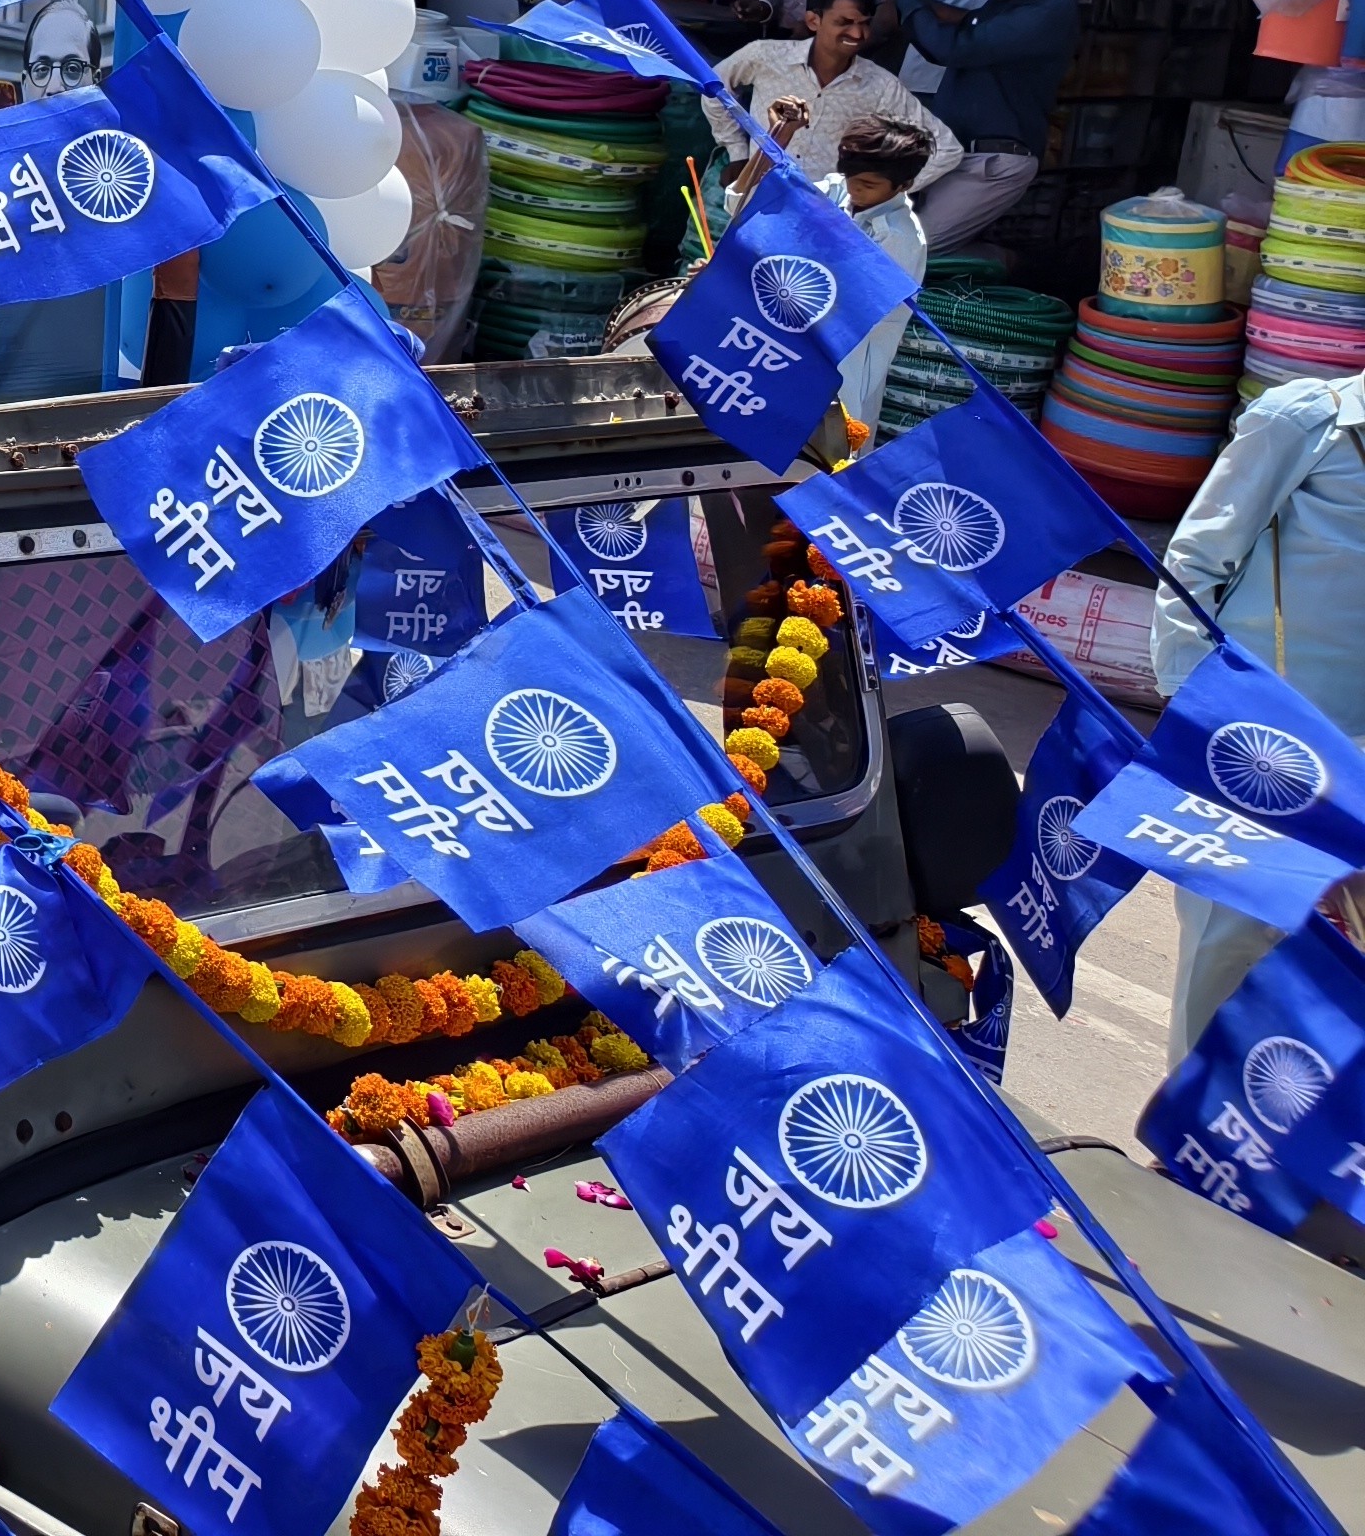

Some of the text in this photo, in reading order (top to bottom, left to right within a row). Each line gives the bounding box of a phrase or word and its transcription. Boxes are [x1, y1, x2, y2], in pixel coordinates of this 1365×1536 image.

[8, 153, 66, 234] जय
[148, 486, 237, 592] भीम
[204, 444, 283, 539] जय
[1019, 603, 1068, 628] Pipes
[644, 934, 726, 1013] जय
[725, 1145, 833, 1273] जय
[667, 1203, 786, 1344] भीम
[193, 1323, 294, 1445] जय
[851, 1354, 954, 1443] जय
[147, 1393, 264, 1525] भीम
